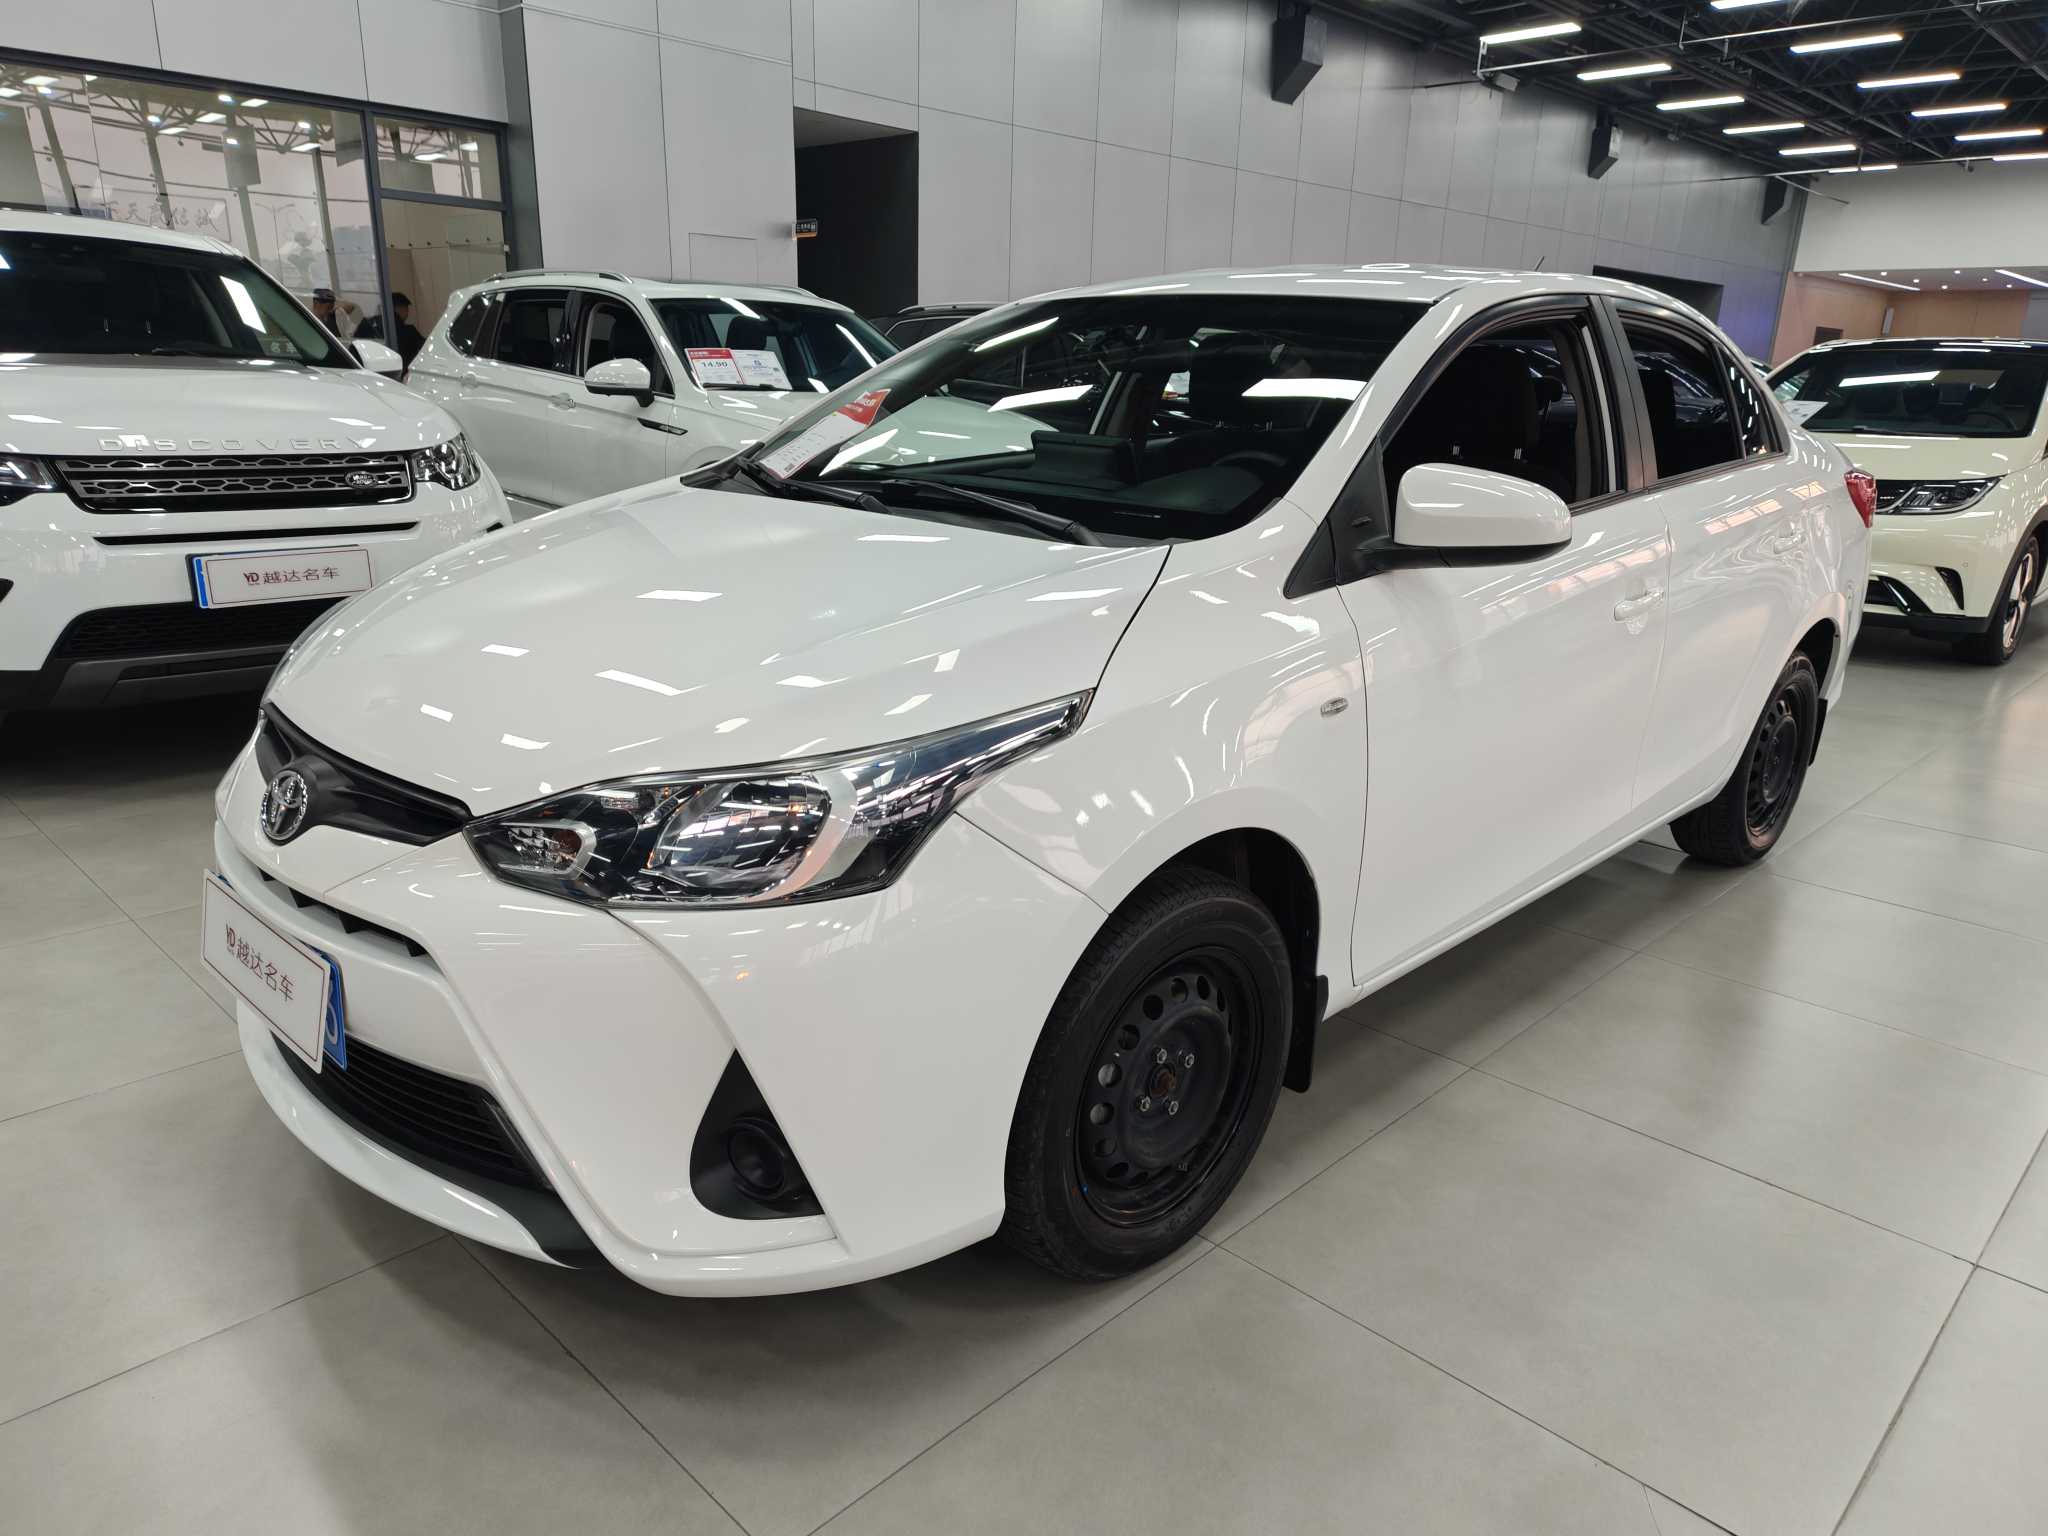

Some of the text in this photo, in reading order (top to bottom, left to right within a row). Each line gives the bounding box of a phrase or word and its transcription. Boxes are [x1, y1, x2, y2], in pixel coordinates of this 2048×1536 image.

[99, 437, 374, 451] DISCOVERY
[262, 566, 340, 585] 越达名车
[236, 936, 295, 1003] 越达名车
